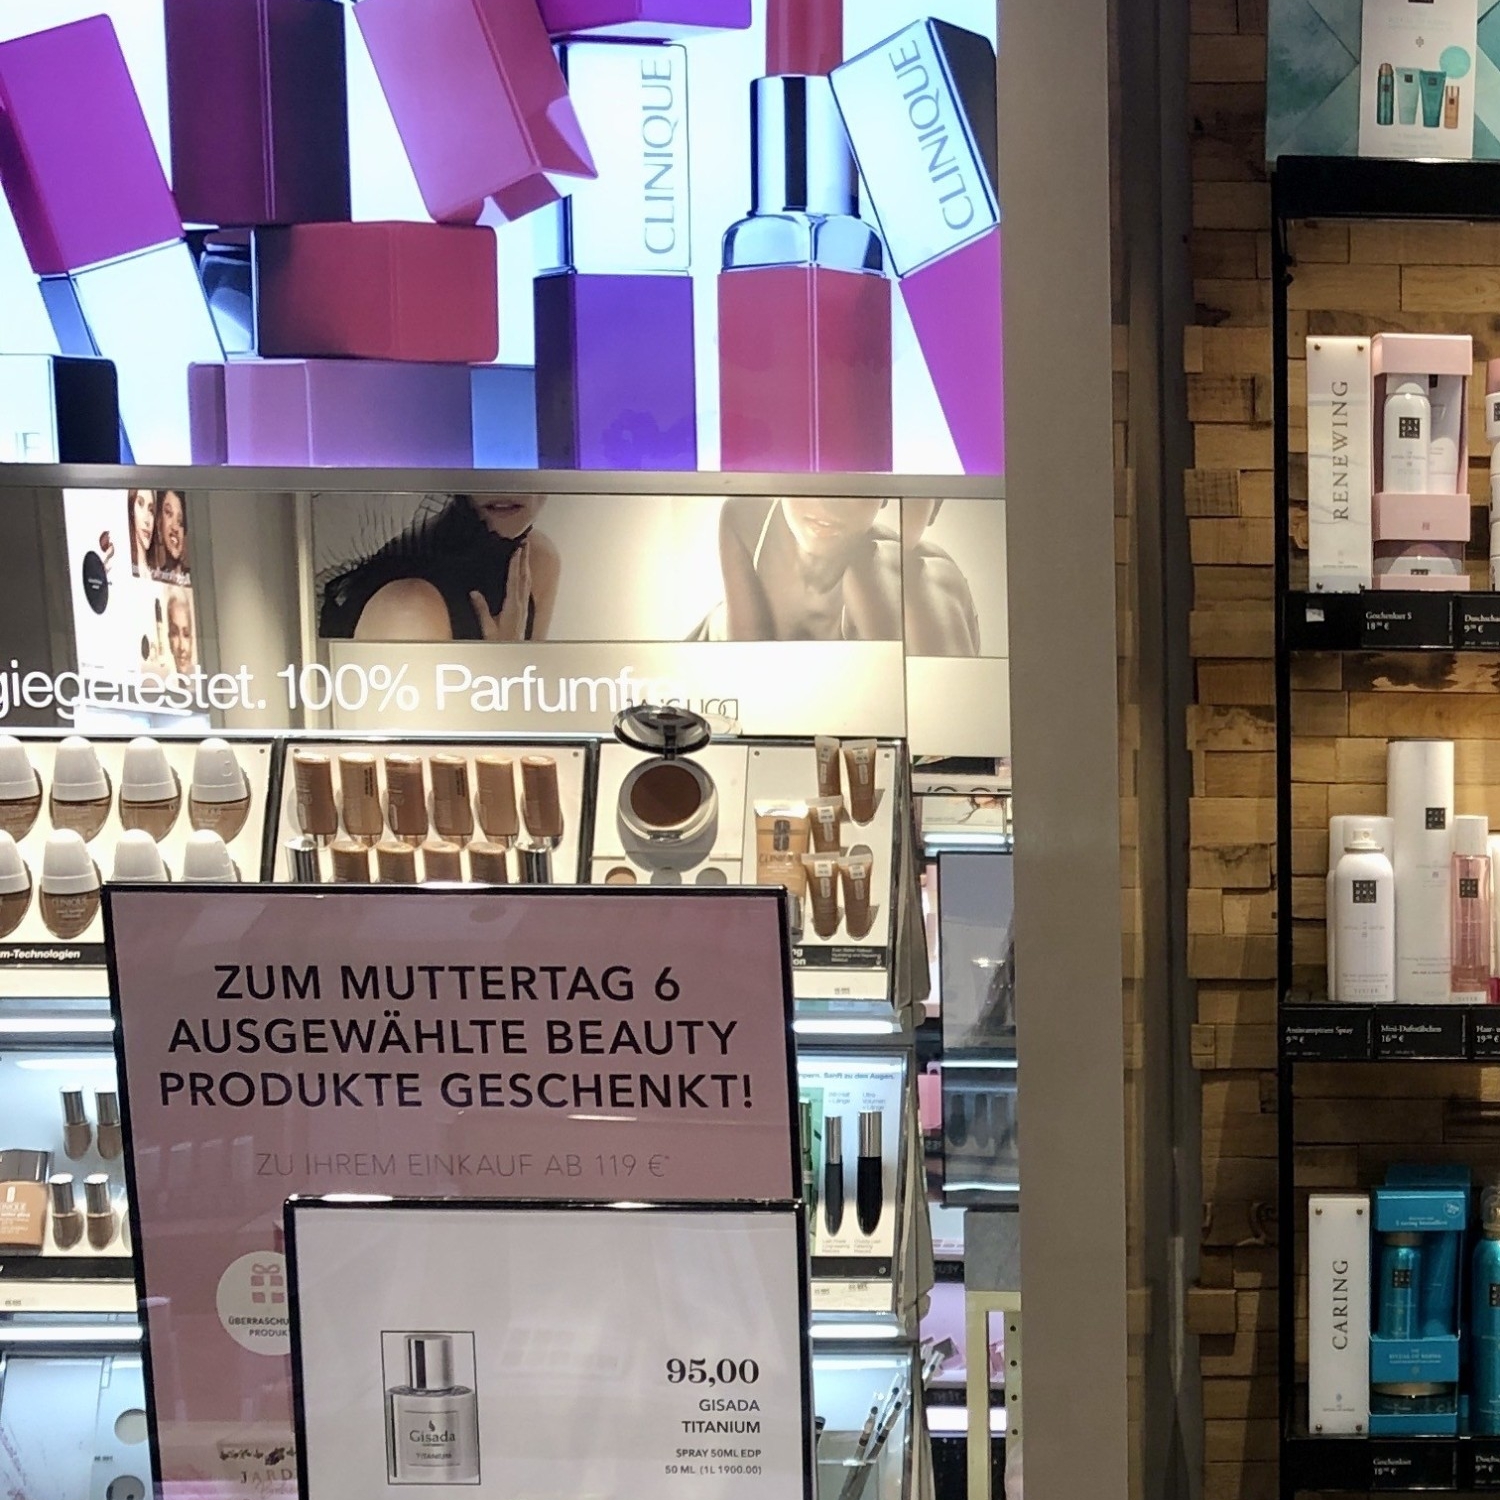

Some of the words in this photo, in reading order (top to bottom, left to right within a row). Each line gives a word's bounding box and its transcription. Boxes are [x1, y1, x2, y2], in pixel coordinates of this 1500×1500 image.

[888, 39, 975, 231] CLINIQUE
[641, 58, 678, 254] CLINIQUE
[1332, 380, 1348, 520] RENEWING
[277, 663, 420, 711] 100%
[214, 964, 322, 1001] ZUM
[341, 965, 635, 1002] MUTTERTAG
[653, 966, 681, 1002] 6
[168, 1009, 528, 1054] AUSGEWÄHLTE
[547, 1020, 738, 1056] BEAUTY
[160, 1071, 423, 1108] PRODUKTE
[441, 1072, 753, 1110] GESCHENKT!
[256, 1153, 295, 1178] ZU
[305, 1153, 397, 1177] IHREM
[408, 1153, 533, 1177] EINKAUF
[545, 1154, 584, 1177] AB
[594, 1154, 637, 1178] 119
[1332, 1259, 1349, 1350] CARING
[228, 1315, 289, 1325] ÜBERRASCHU
[249, 1329, 290, 1337] PRODUK
[666, 1358, 759, 1387] 95,00
[698, 1399, 760, 1412] GISADA
[409, 1429, 456, 1443] Gisada
[681, 1420, 761, 1434] TITANIUM
[676, 1449, 708, 1458] SPRAY
[711, 1449, 738, 1458] 50ML
[740, 1449, 761, 1458] EDP
[240, 1468, 293, 1484] JARD
[665, 1465, 678, 1475] 50
[680, 1465, 696, 1475] ML
[700, 1465, 715, 1476] (1L
[718, 1465, 762, 1476] 1900.00)
